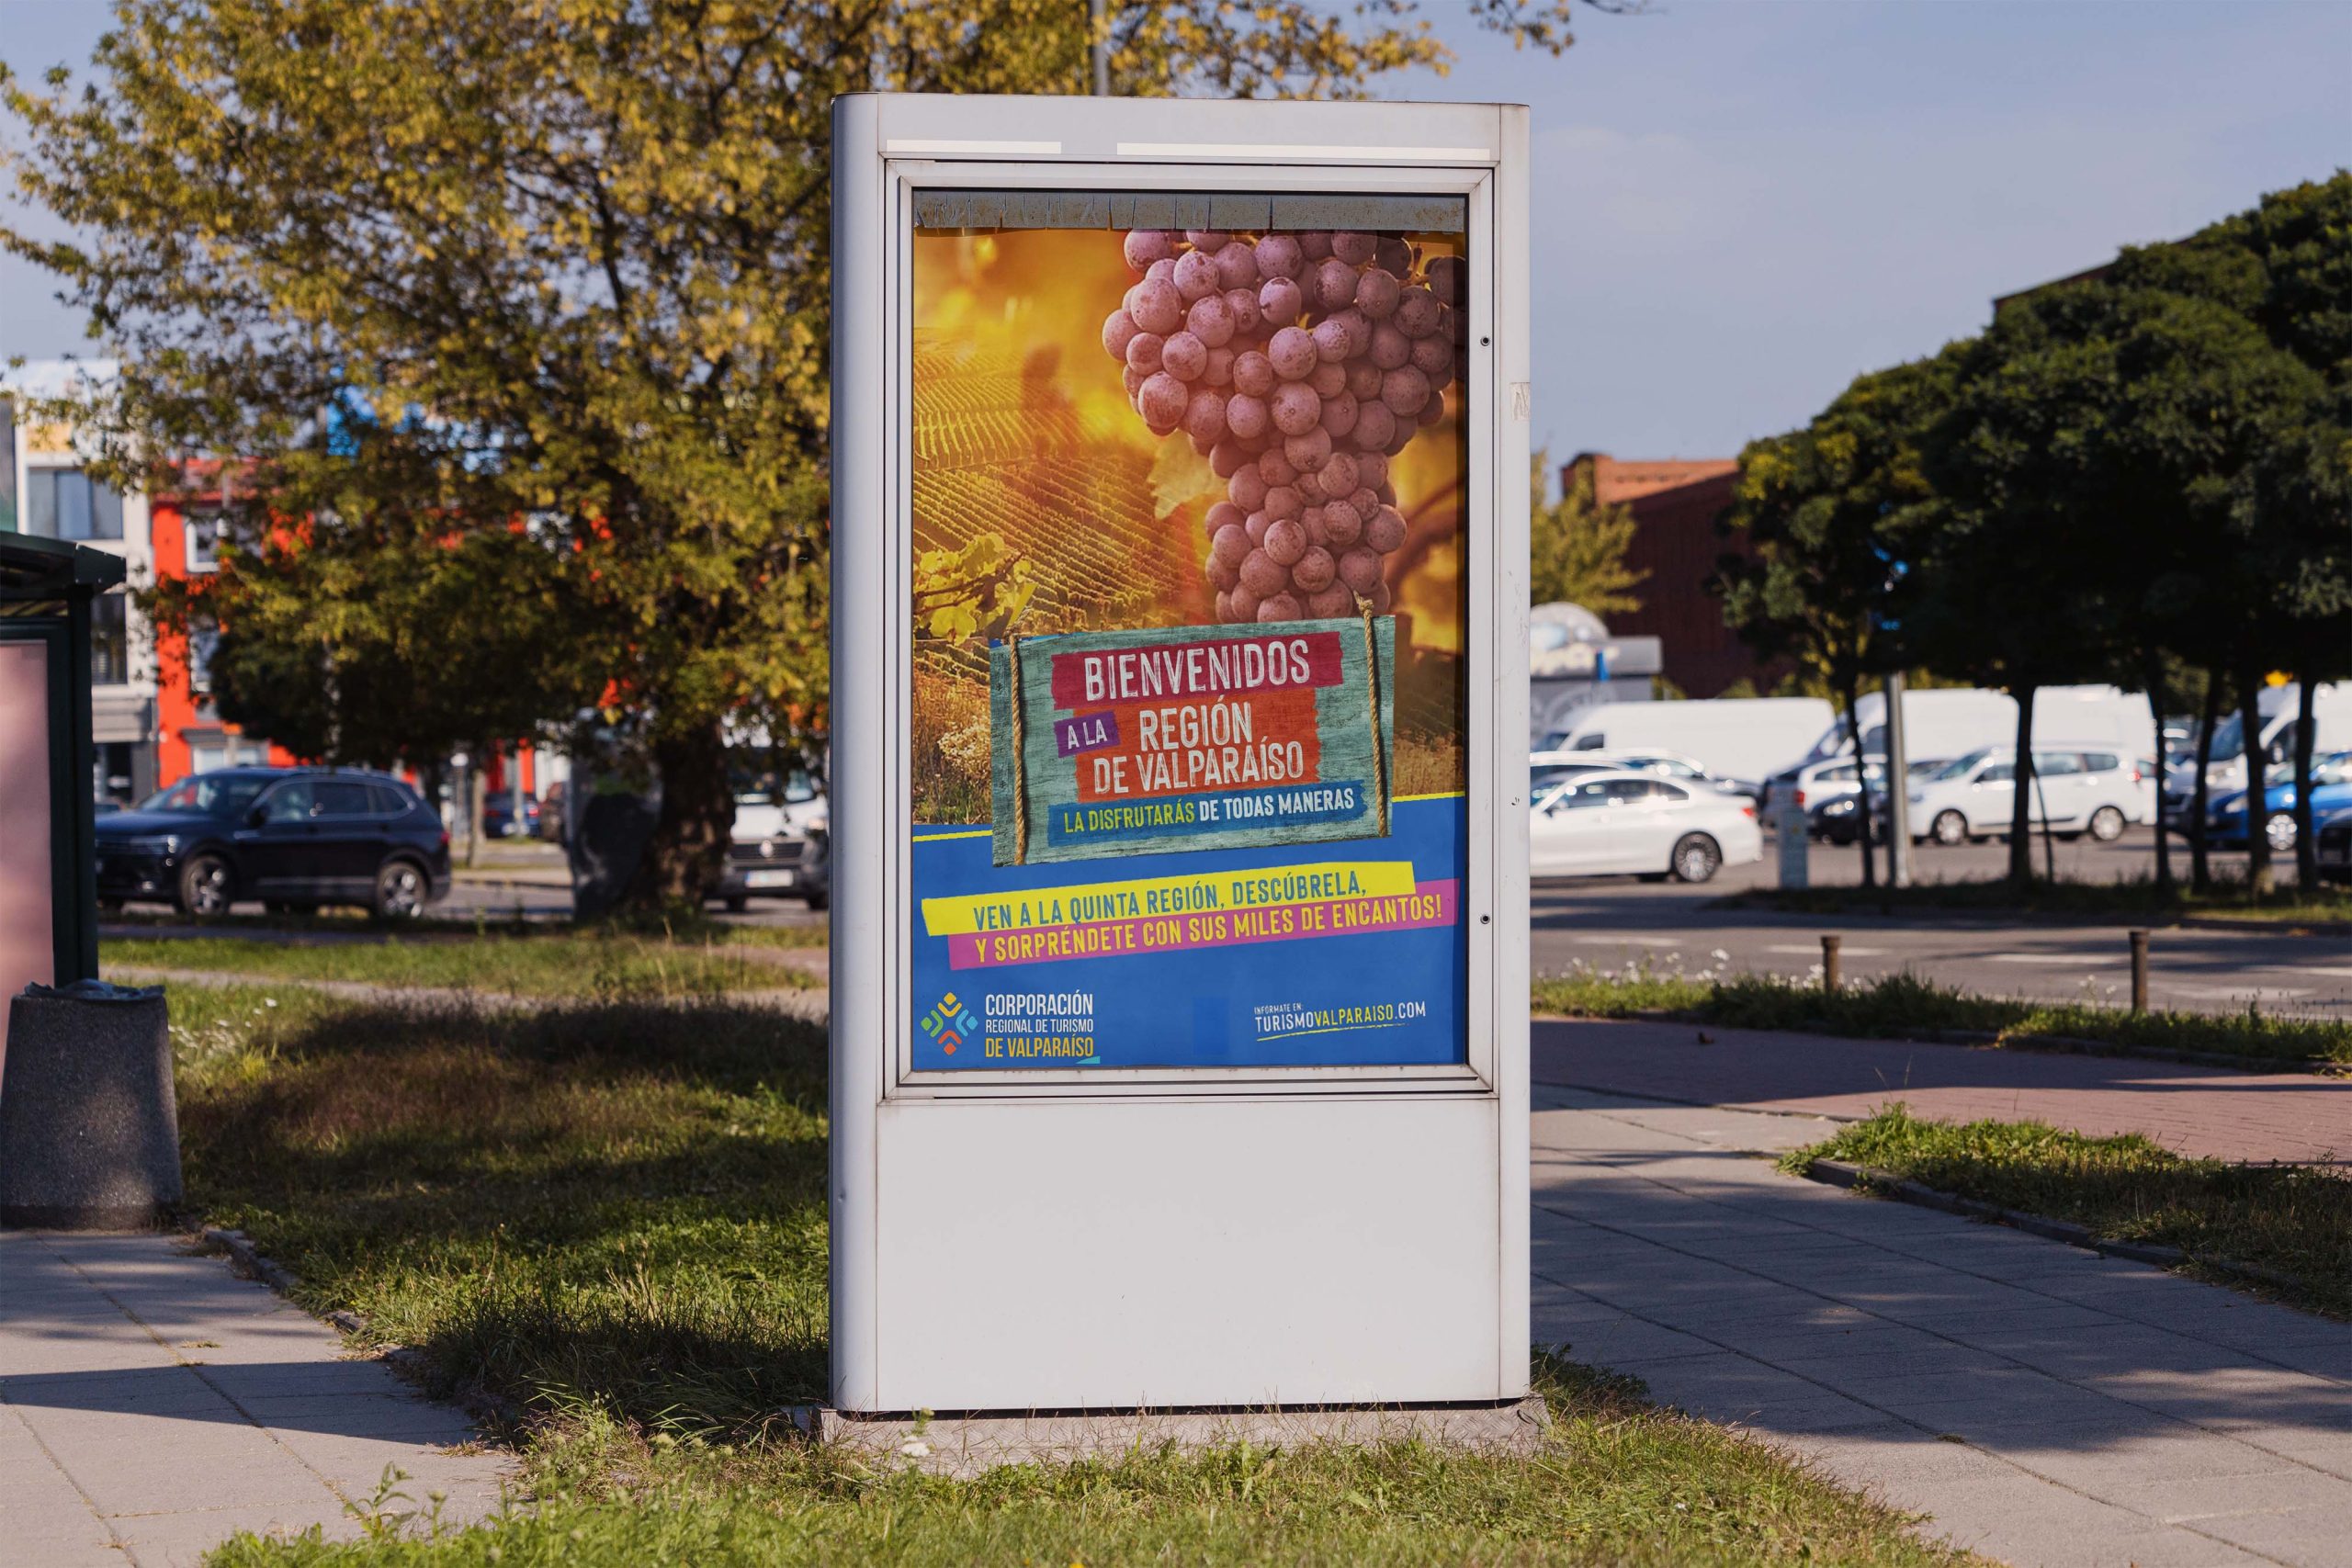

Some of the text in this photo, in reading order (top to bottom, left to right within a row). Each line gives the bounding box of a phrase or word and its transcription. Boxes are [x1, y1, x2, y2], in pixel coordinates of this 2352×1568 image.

[1085, 639, 1310, 702] BIENVENIDOS
[1068, 694, 1253, 751] A LA REGIÓN
[1093, 737, 1304, 795] DE VALPARAÍSO
[1064, 787, 1355, 834] LA DISFRUTARÁS DE TODAS MANERAS
[973, 871, 1366, 931] VEN A LA QUINTA REGIÓN, DESCÚBRELA,
[975, 894, 1442, 964] Y SORPRÉNDETE CON SUS MILES DE ENCANTOS!
[985, 988, 1093, 1016] CORPORACIÓN
[985, 1018, 1093, 1033] REGIONAL DE TURISMO
[1254, 1000, 1427, 1032] TURISMOVALPARAISO.COM
[985, 1033, 1094, 1057] DE VALPARAÍSO
